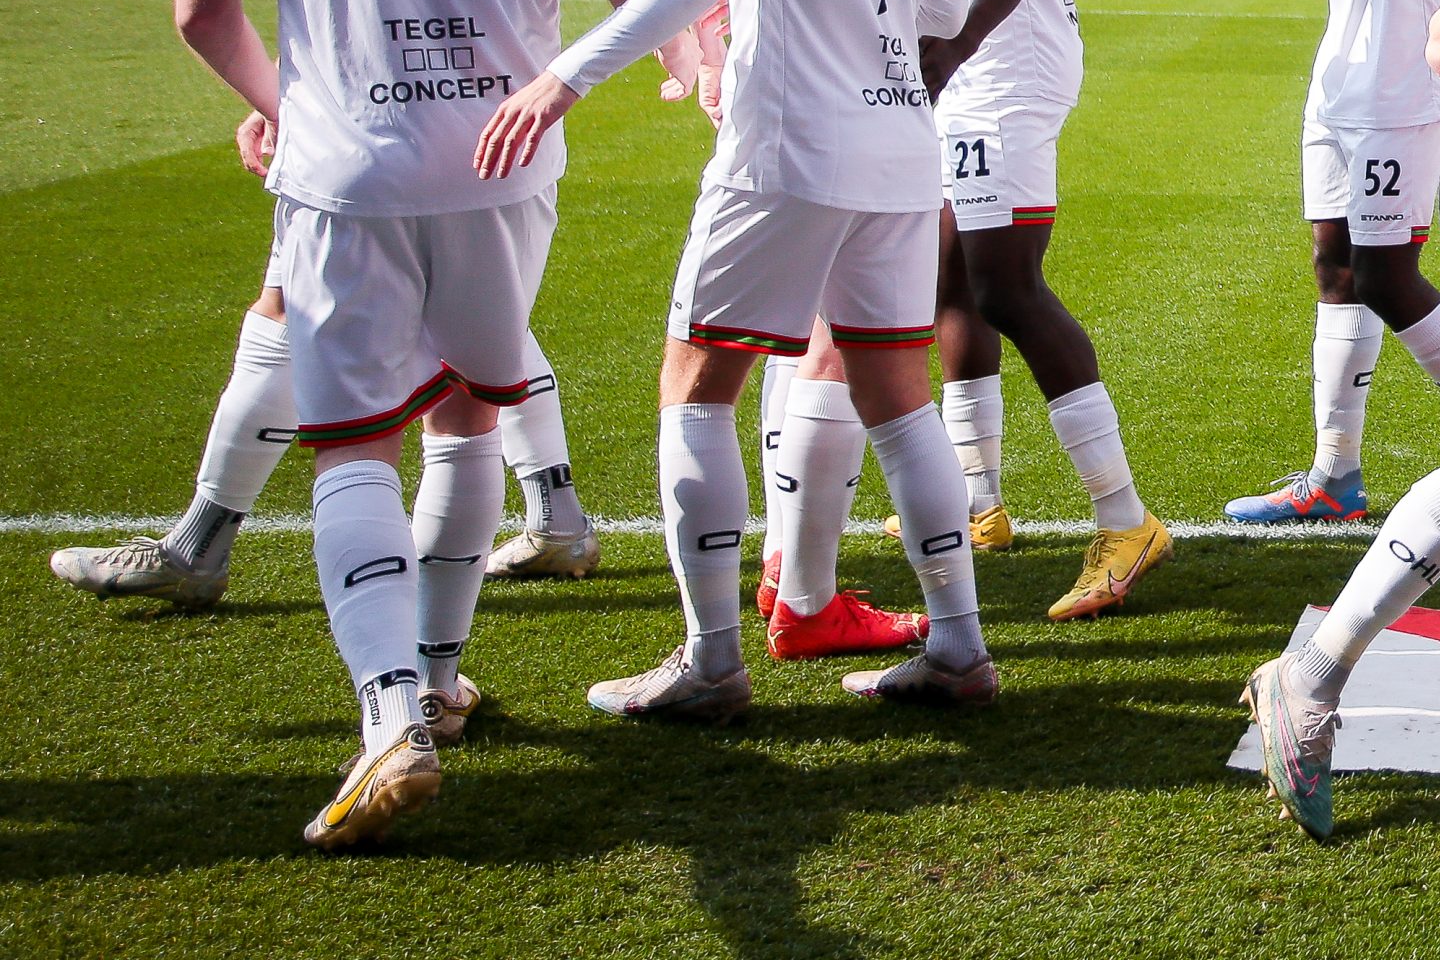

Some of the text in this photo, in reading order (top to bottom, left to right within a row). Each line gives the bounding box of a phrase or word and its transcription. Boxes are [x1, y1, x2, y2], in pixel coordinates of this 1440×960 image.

[384, 17, 485, 41] TEGEL
[369, 75, 512, 105] CONCEPT
[955, 139, 990, 179] 21
[1365, 159, 1401, 196] 52
[956, 195, 998, 205] STANNO
[365, 681, 382, 726] DESIGN
